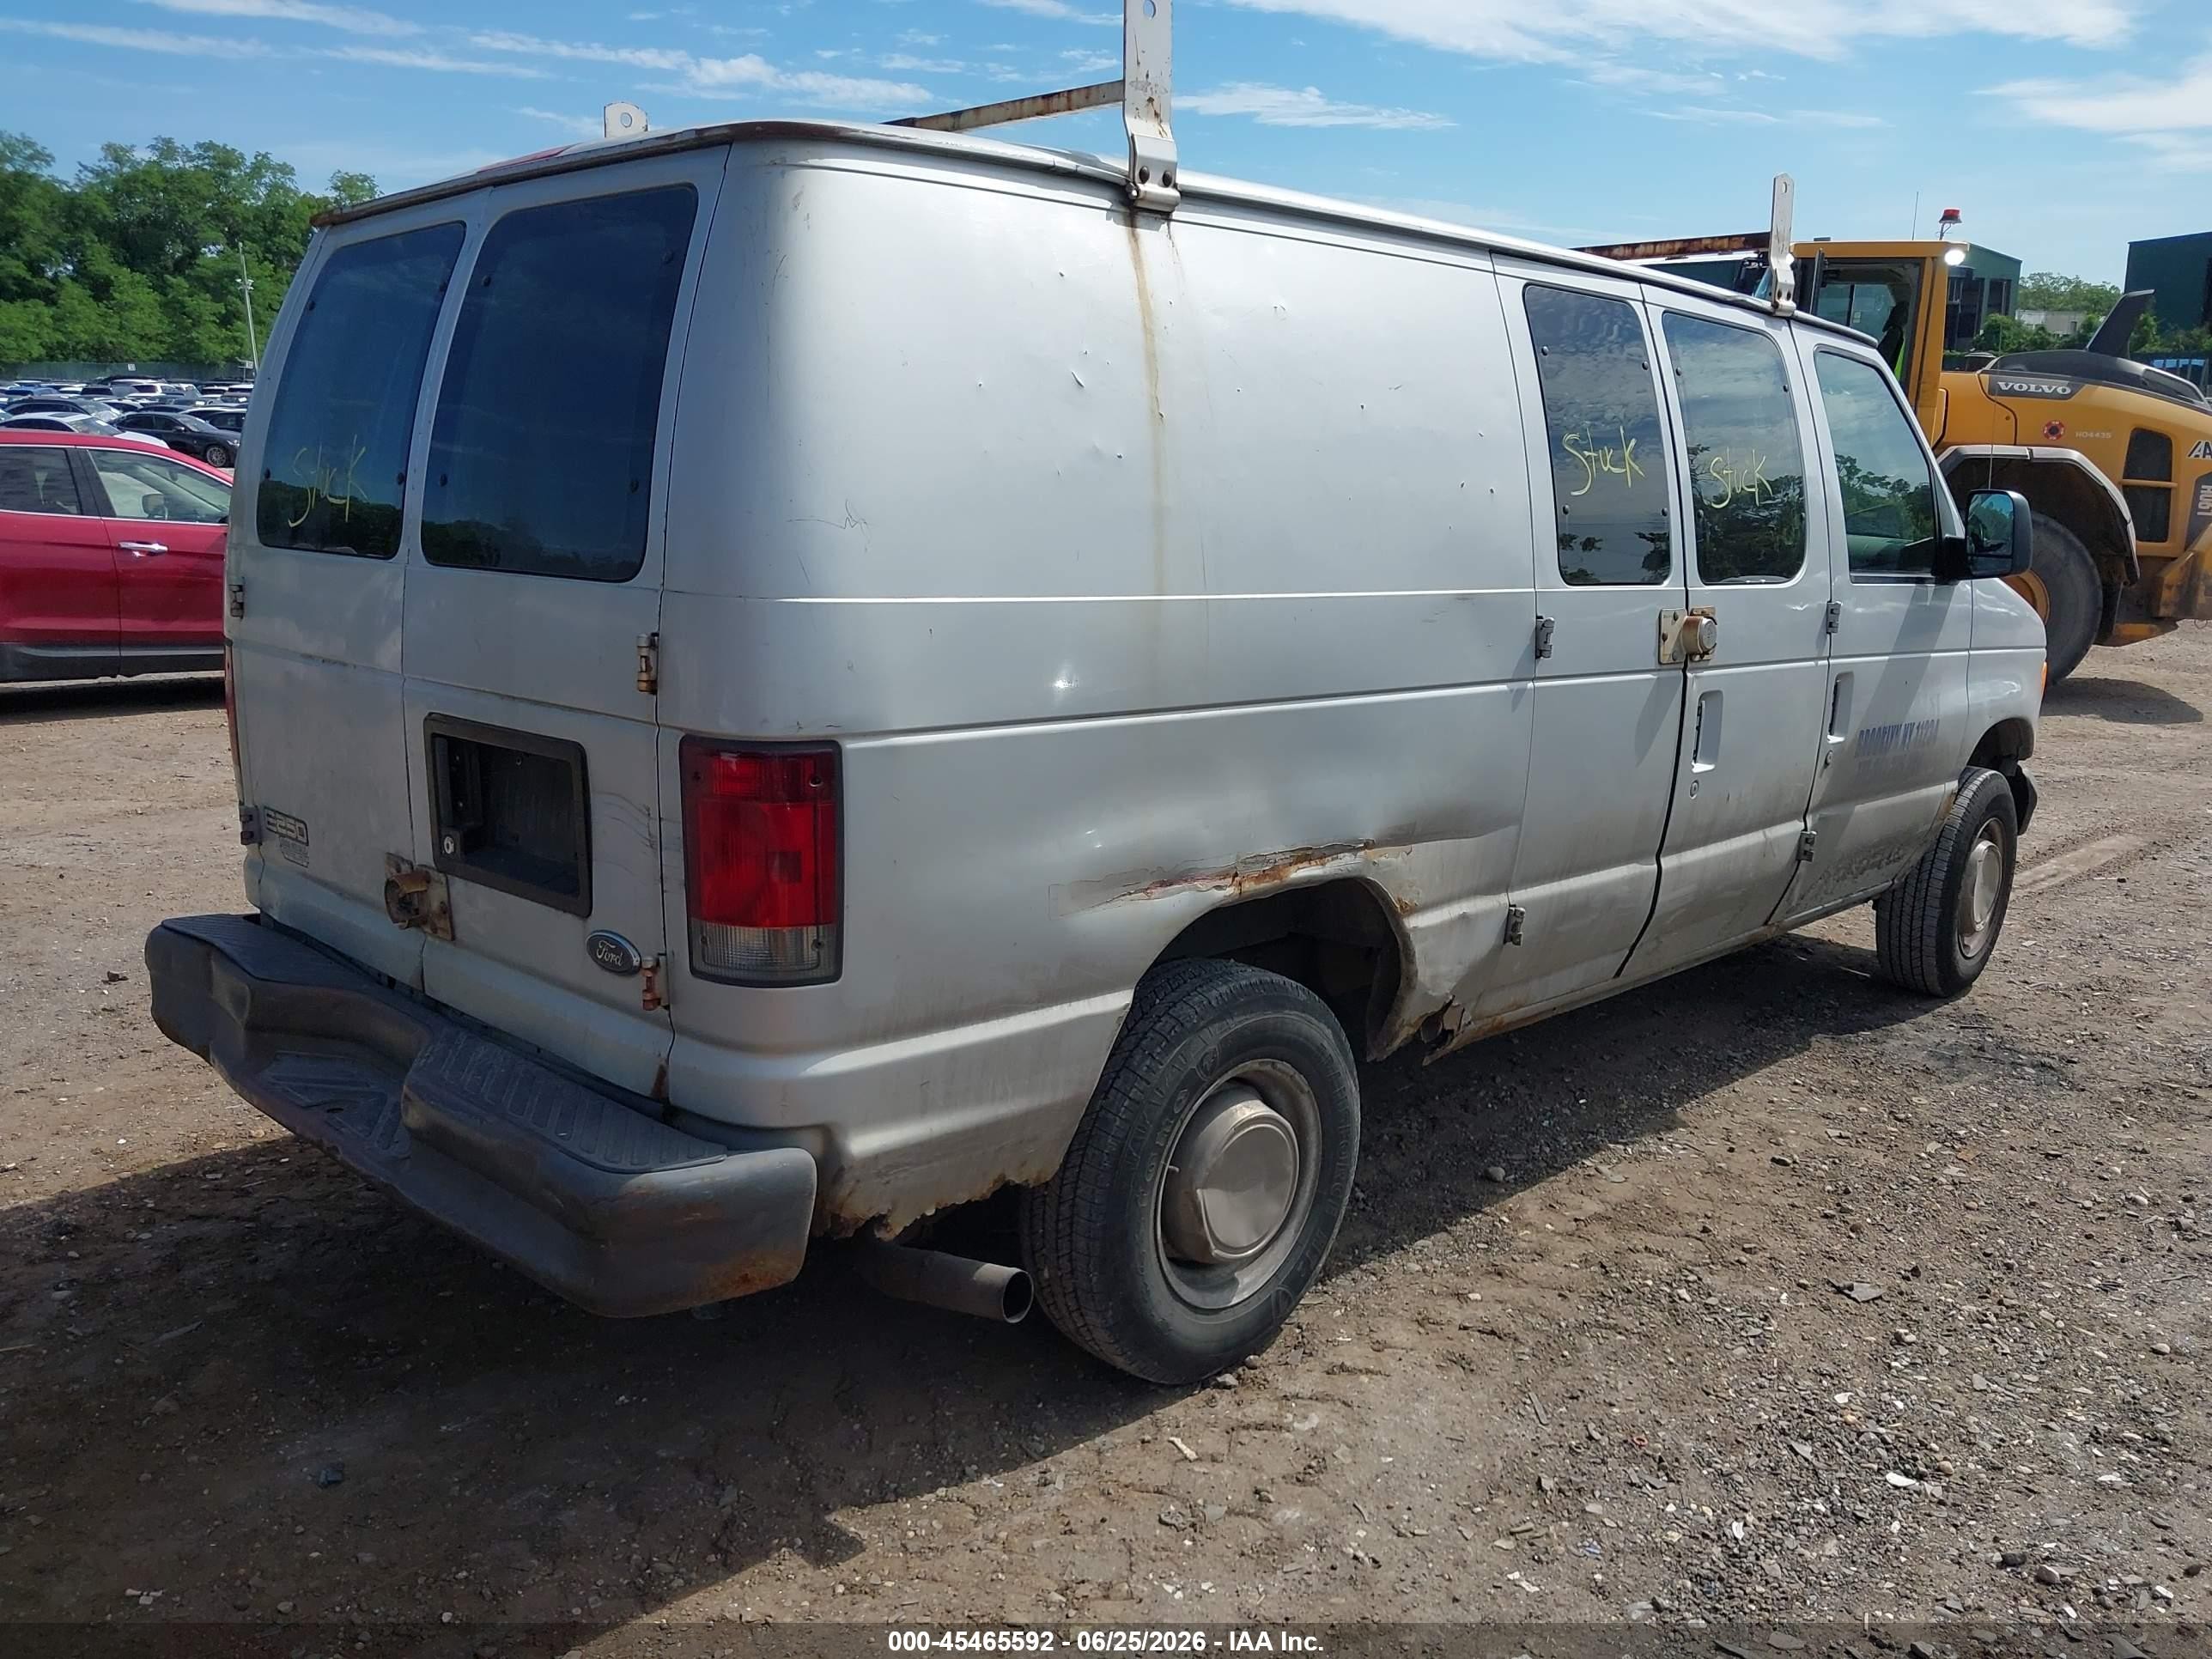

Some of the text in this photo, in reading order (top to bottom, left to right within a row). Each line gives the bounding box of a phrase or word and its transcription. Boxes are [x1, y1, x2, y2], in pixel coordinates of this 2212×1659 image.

[1997, 381, 2072, 395] VOLVO
[288, 434, 371, 527] Stuck
[1562, 426, 1646, 495] Stuck
[1710, 447, 1773, 509] Stuck
[596, 939, 623, 967] Ford
